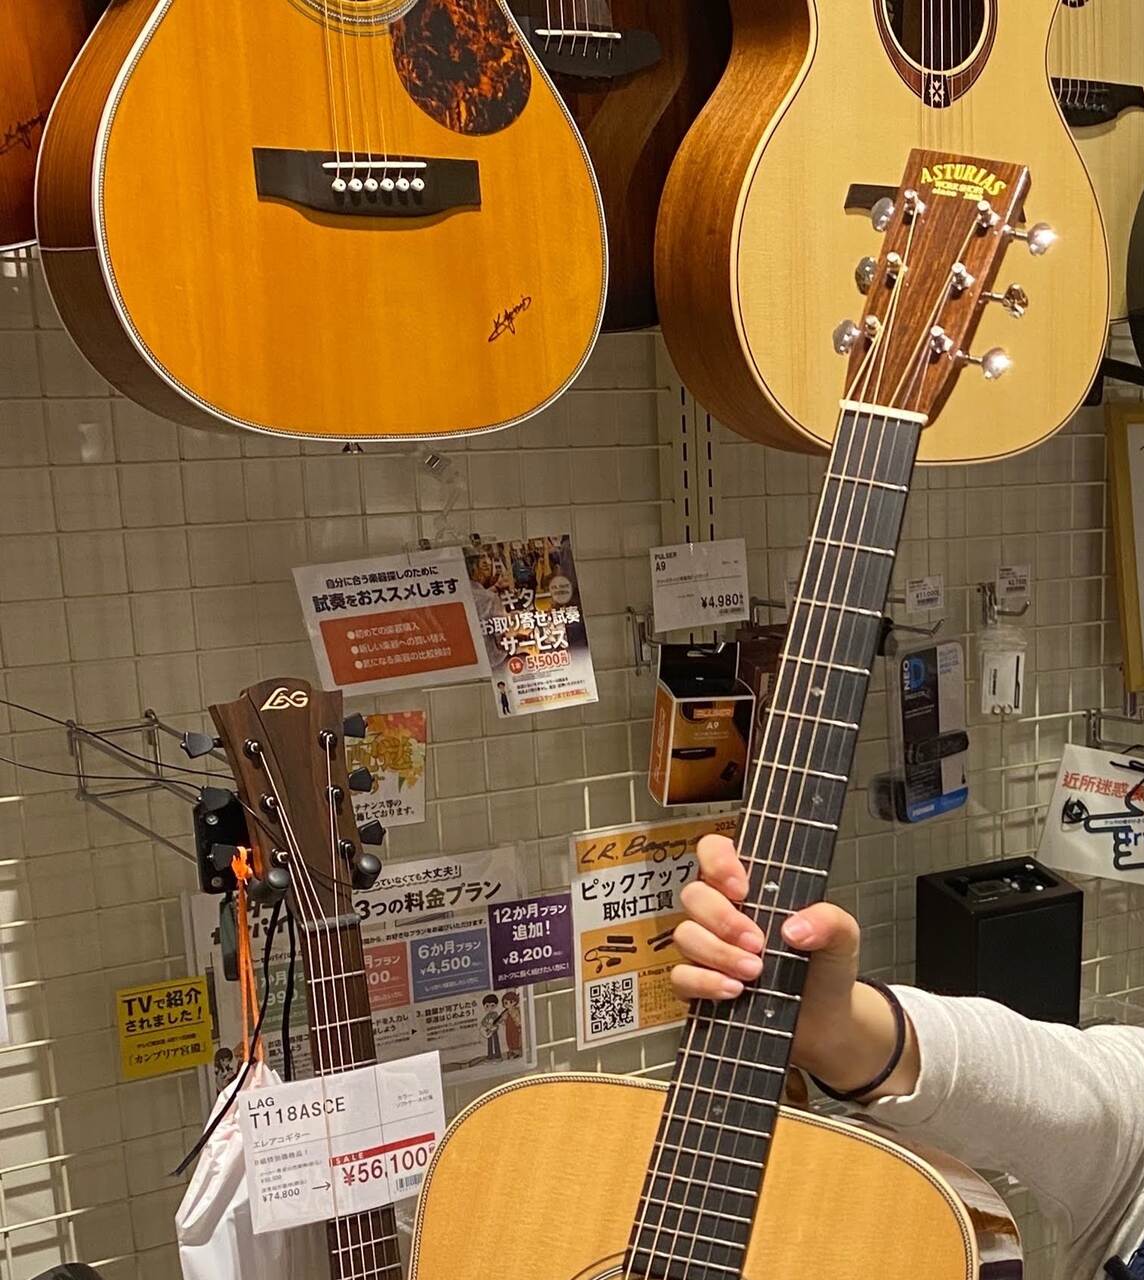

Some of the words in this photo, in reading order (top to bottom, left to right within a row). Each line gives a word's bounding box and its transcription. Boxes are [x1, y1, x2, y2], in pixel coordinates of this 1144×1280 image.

[921, 163, 1006, 195] ASTURIAS
[326, 566, 438, 589] 自分に合う楽器探しのために
[656, 561, 666, 572] A9
[312, 578, 458, 613] 試奏をおススメします
[502, 587, 551, 610] ギター
[481, 606, 580, 635] お取り寄せ・試奏
[501, 627, 569, 656] サービス
[903, 660, 911, 690] NEO
[706, 721, 719, 730] A9
[715, 819, 737, 832] 2025
[581, 861, 694, 901] ピックアップ
[355, 881, 501, 920] 3つの料金プラン
[603, 890, 673, 922] 取付工賃
[494, 903, 567, 924] 12か月プラン
[512, 922, 550, 941] 追加！
[418, 941, 481, 959] 6か月プラン
[502, 945, 552, 965] ¥8,200
[420, 956, 471, 976] ¥4,500
[122, 988, 201, 1016] TVで紹介
[125, 1007, 202, 1032] されました！
[248, 1097, 275, 1110] LAG
[250, 1096, 346, 1129] T118ASCE
[253, 1133, 311, 1148] エレアコギター
[336, 1152, 364, 1164] SALE
[342, 1147, 428, 1186] ¥56,100
[262, 1188, 300, 1202] ¥74,800
